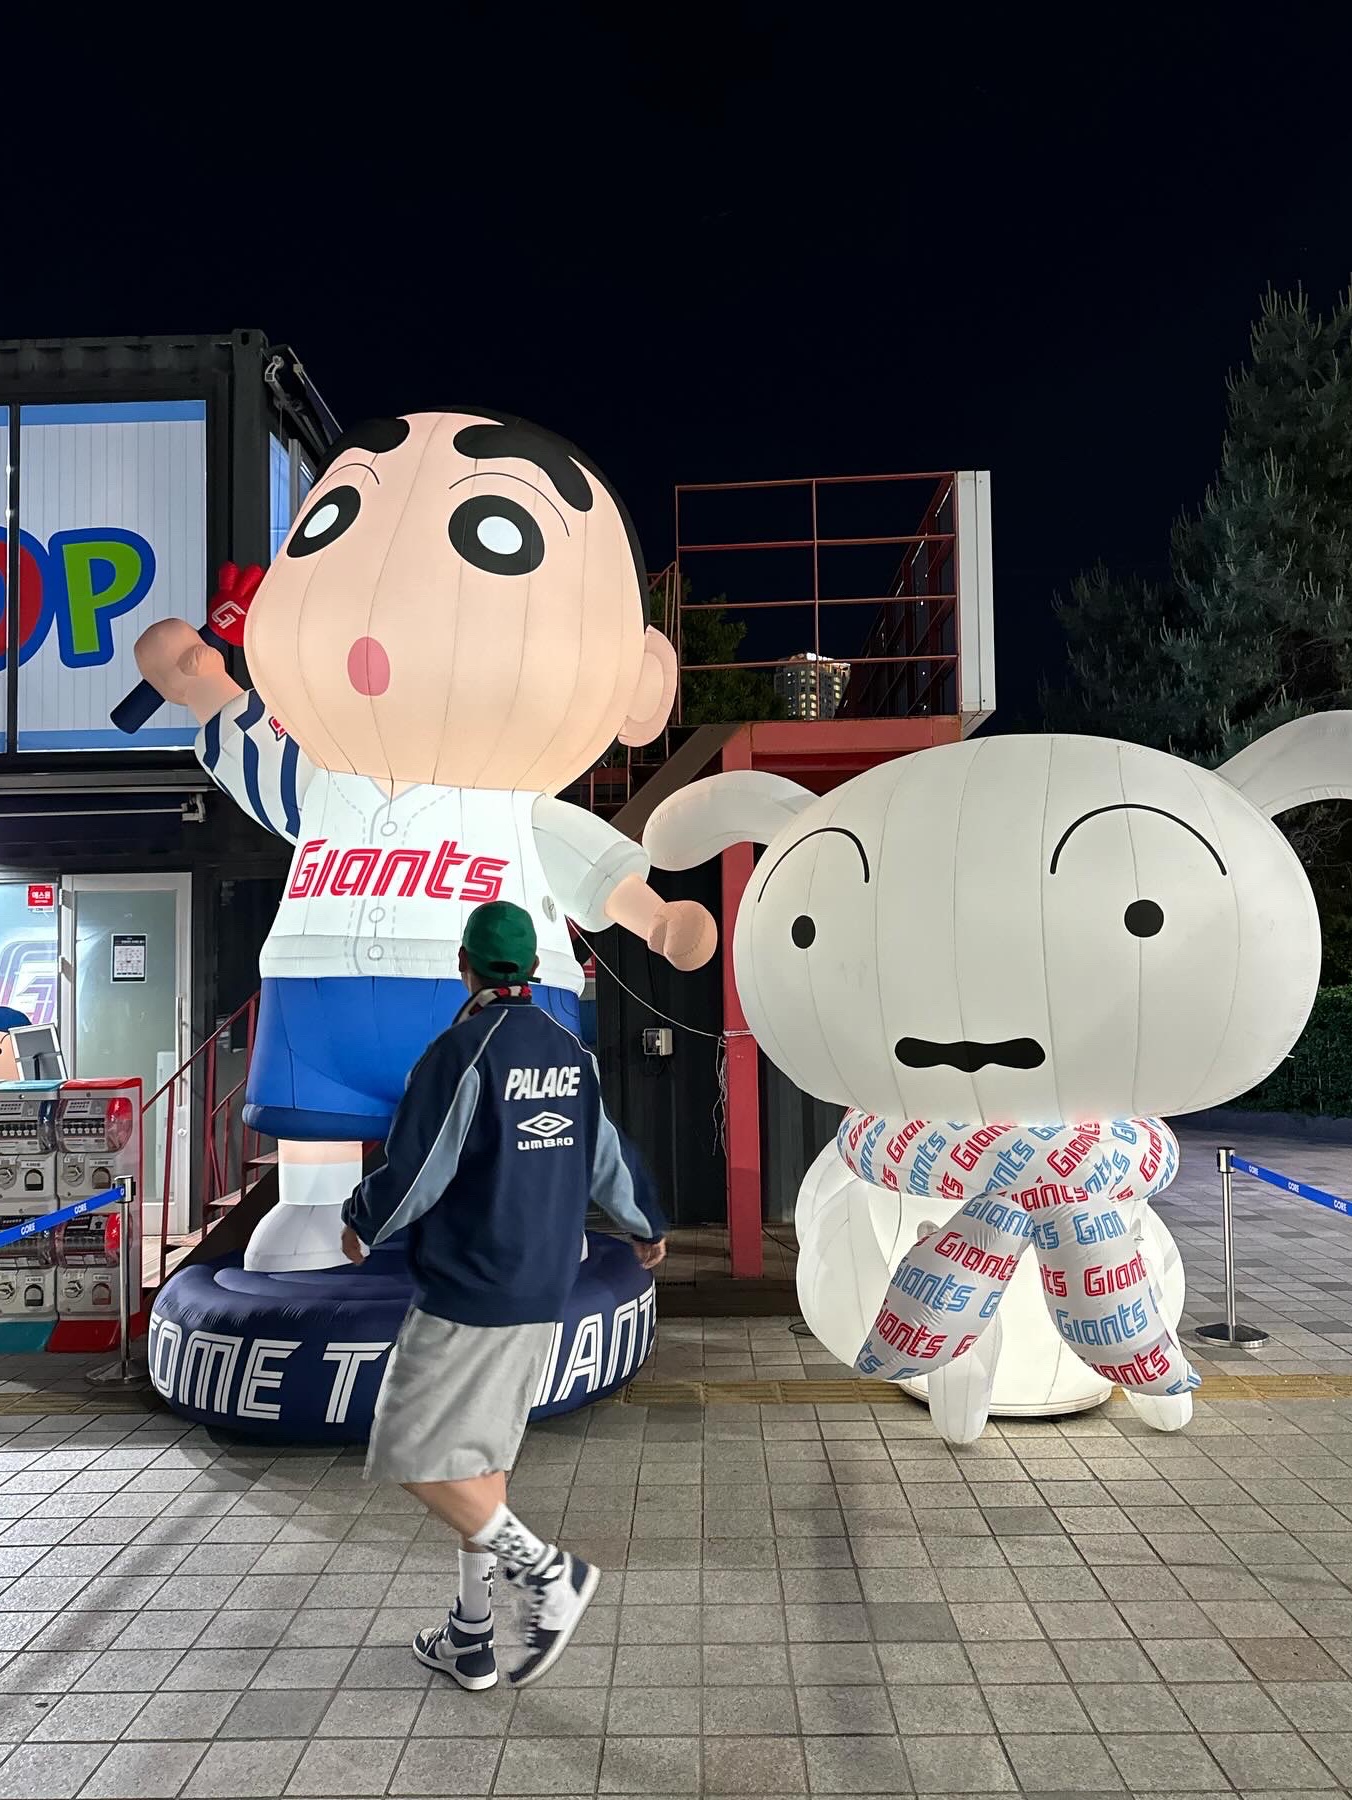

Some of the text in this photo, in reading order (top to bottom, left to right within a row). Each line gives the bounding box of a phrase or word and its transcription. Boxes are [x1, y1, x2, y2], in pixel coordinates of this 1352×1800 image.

[288, 838, 510, 902] Giants
[504, 1066, 581, 1101] PALACE
[1248, 1165, 1259, 1176] CORE
[1287, 1181, 1300, 1193] CORE
[74, 1203, 87, 1214] CORE
[1333, 1199, 1347, 1212] CORE
[20, 1223, 36, 1235] CORE
[1056, 1298, 1149, 1347] Giants
